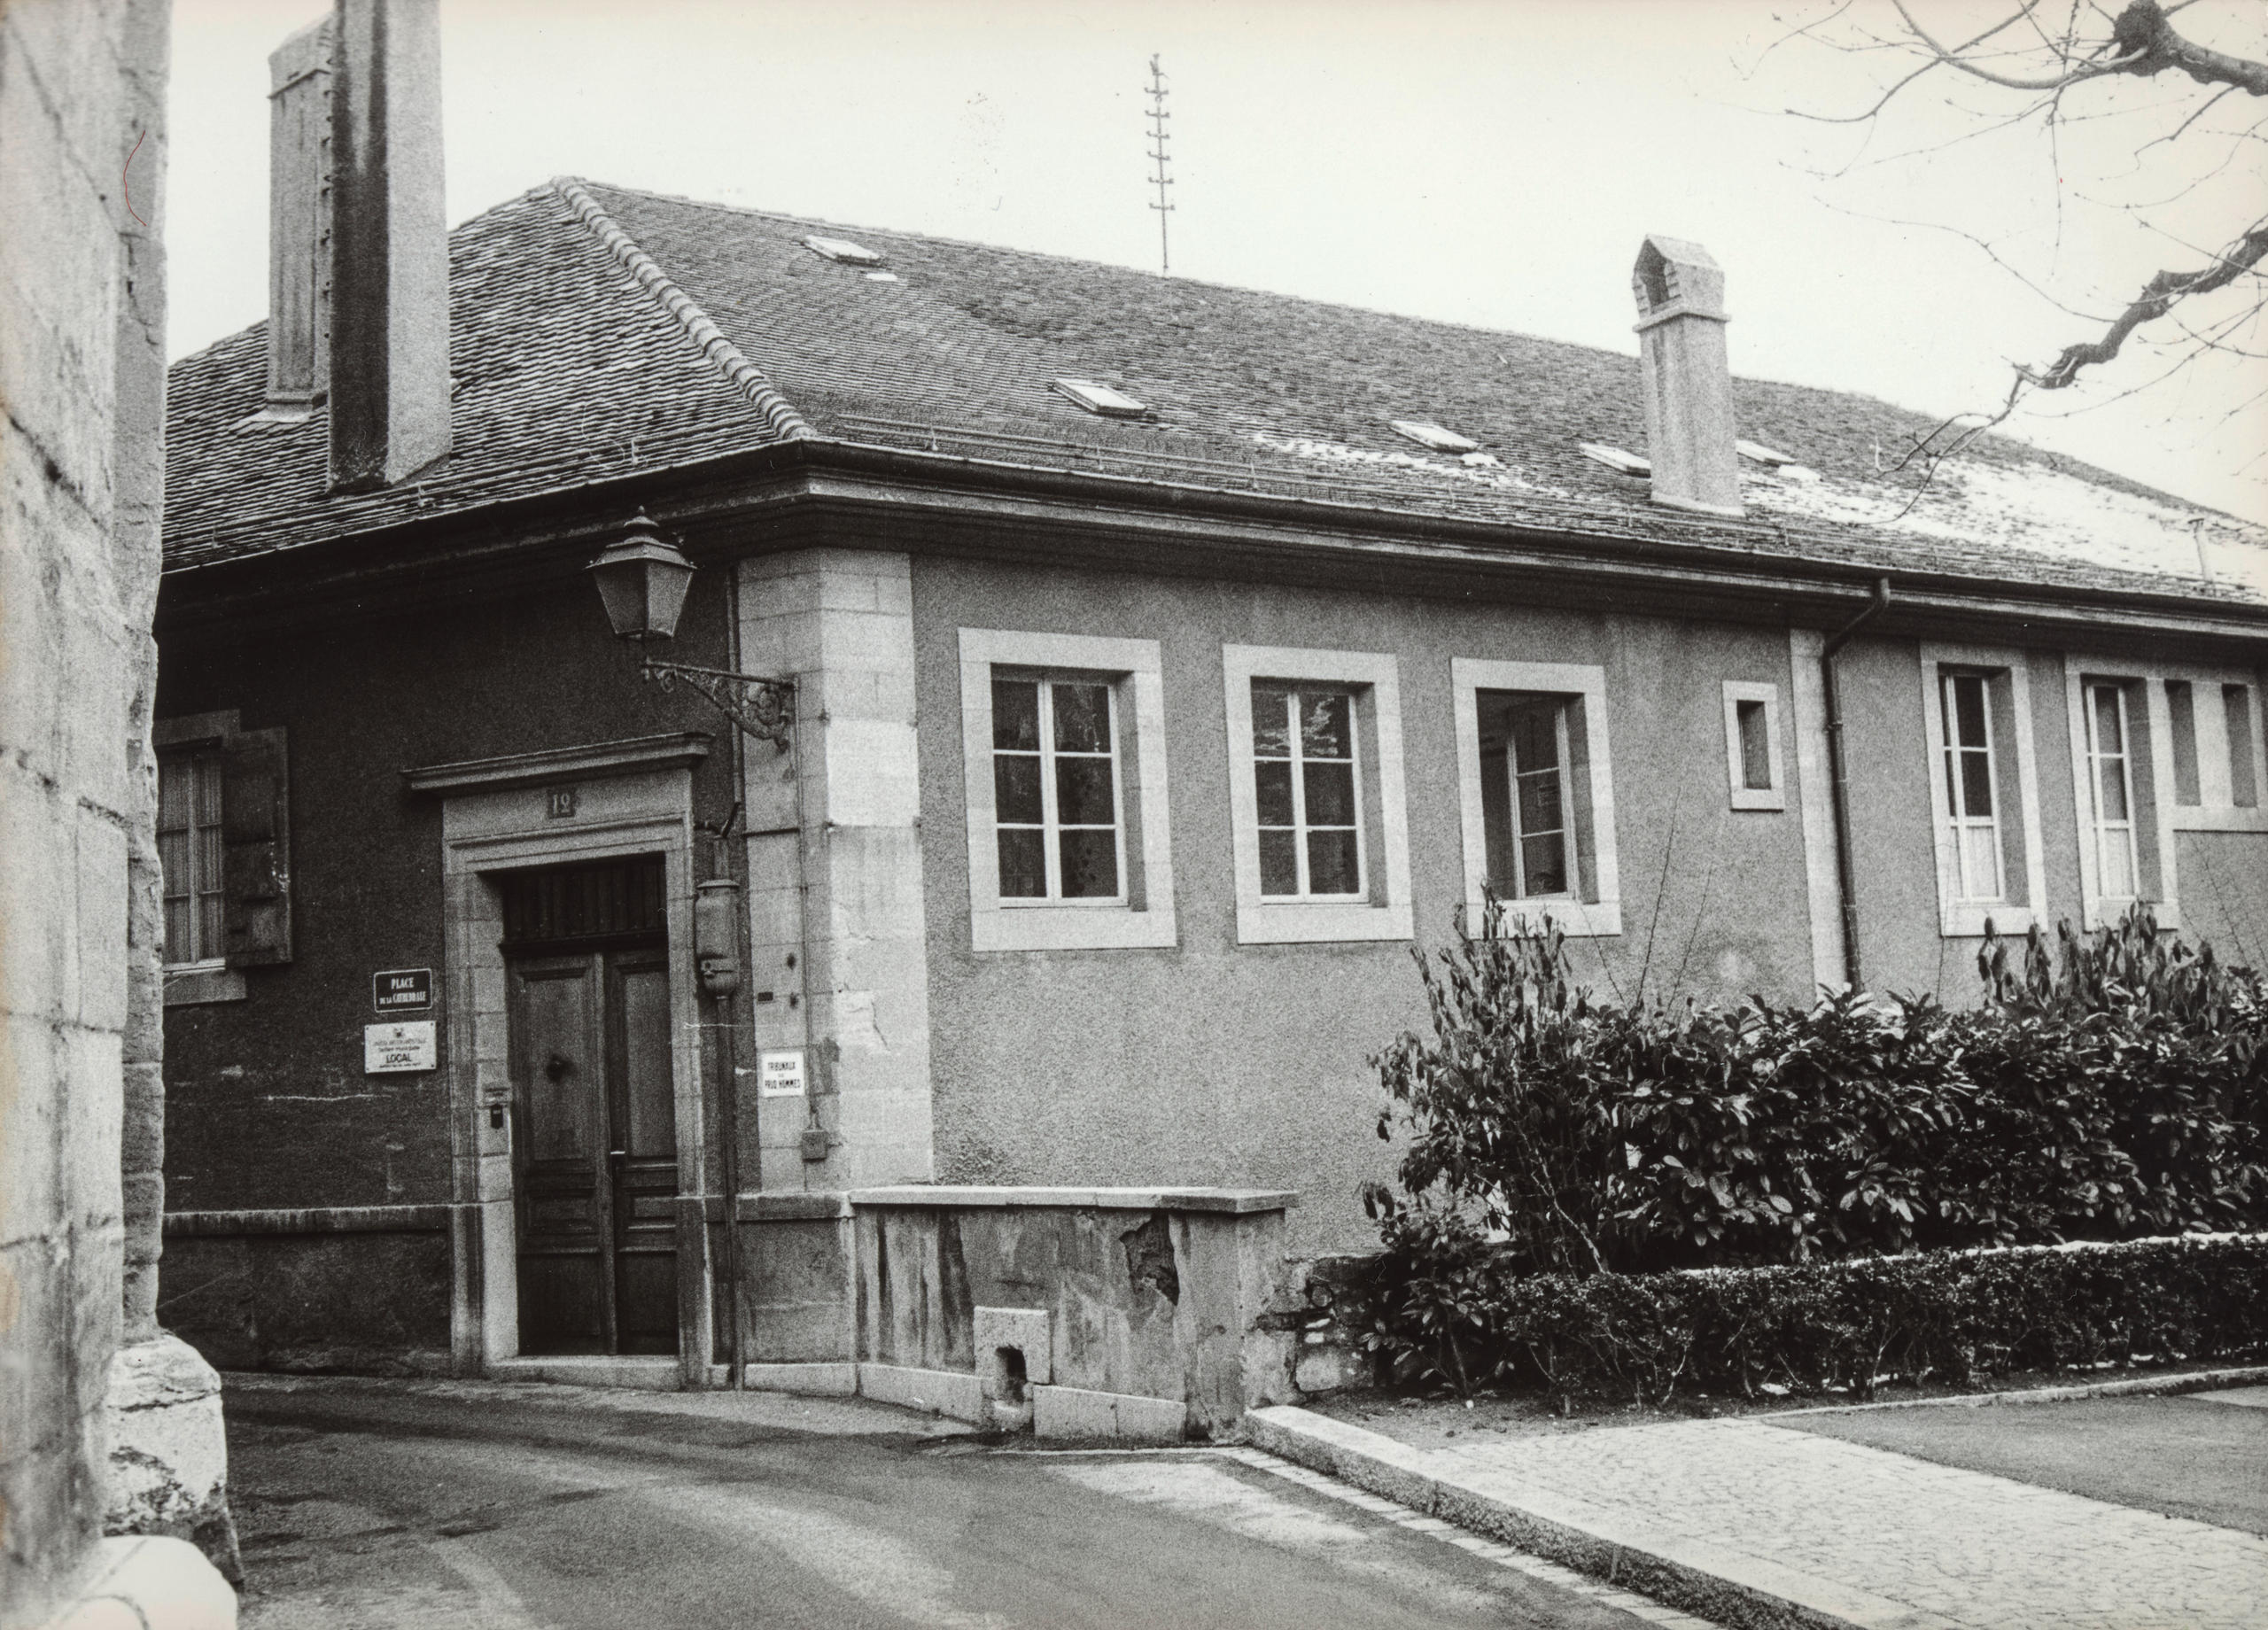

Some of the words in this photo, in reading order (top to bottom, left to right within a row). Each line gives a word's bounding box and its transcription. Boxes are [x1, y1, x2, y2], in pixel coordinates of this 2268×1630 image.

[391, 978, 414, 990] PLACE
[386, 1053, 412, 1064] LOCAL
[767, 1062, 796, 1071] TRIBUNAUX
